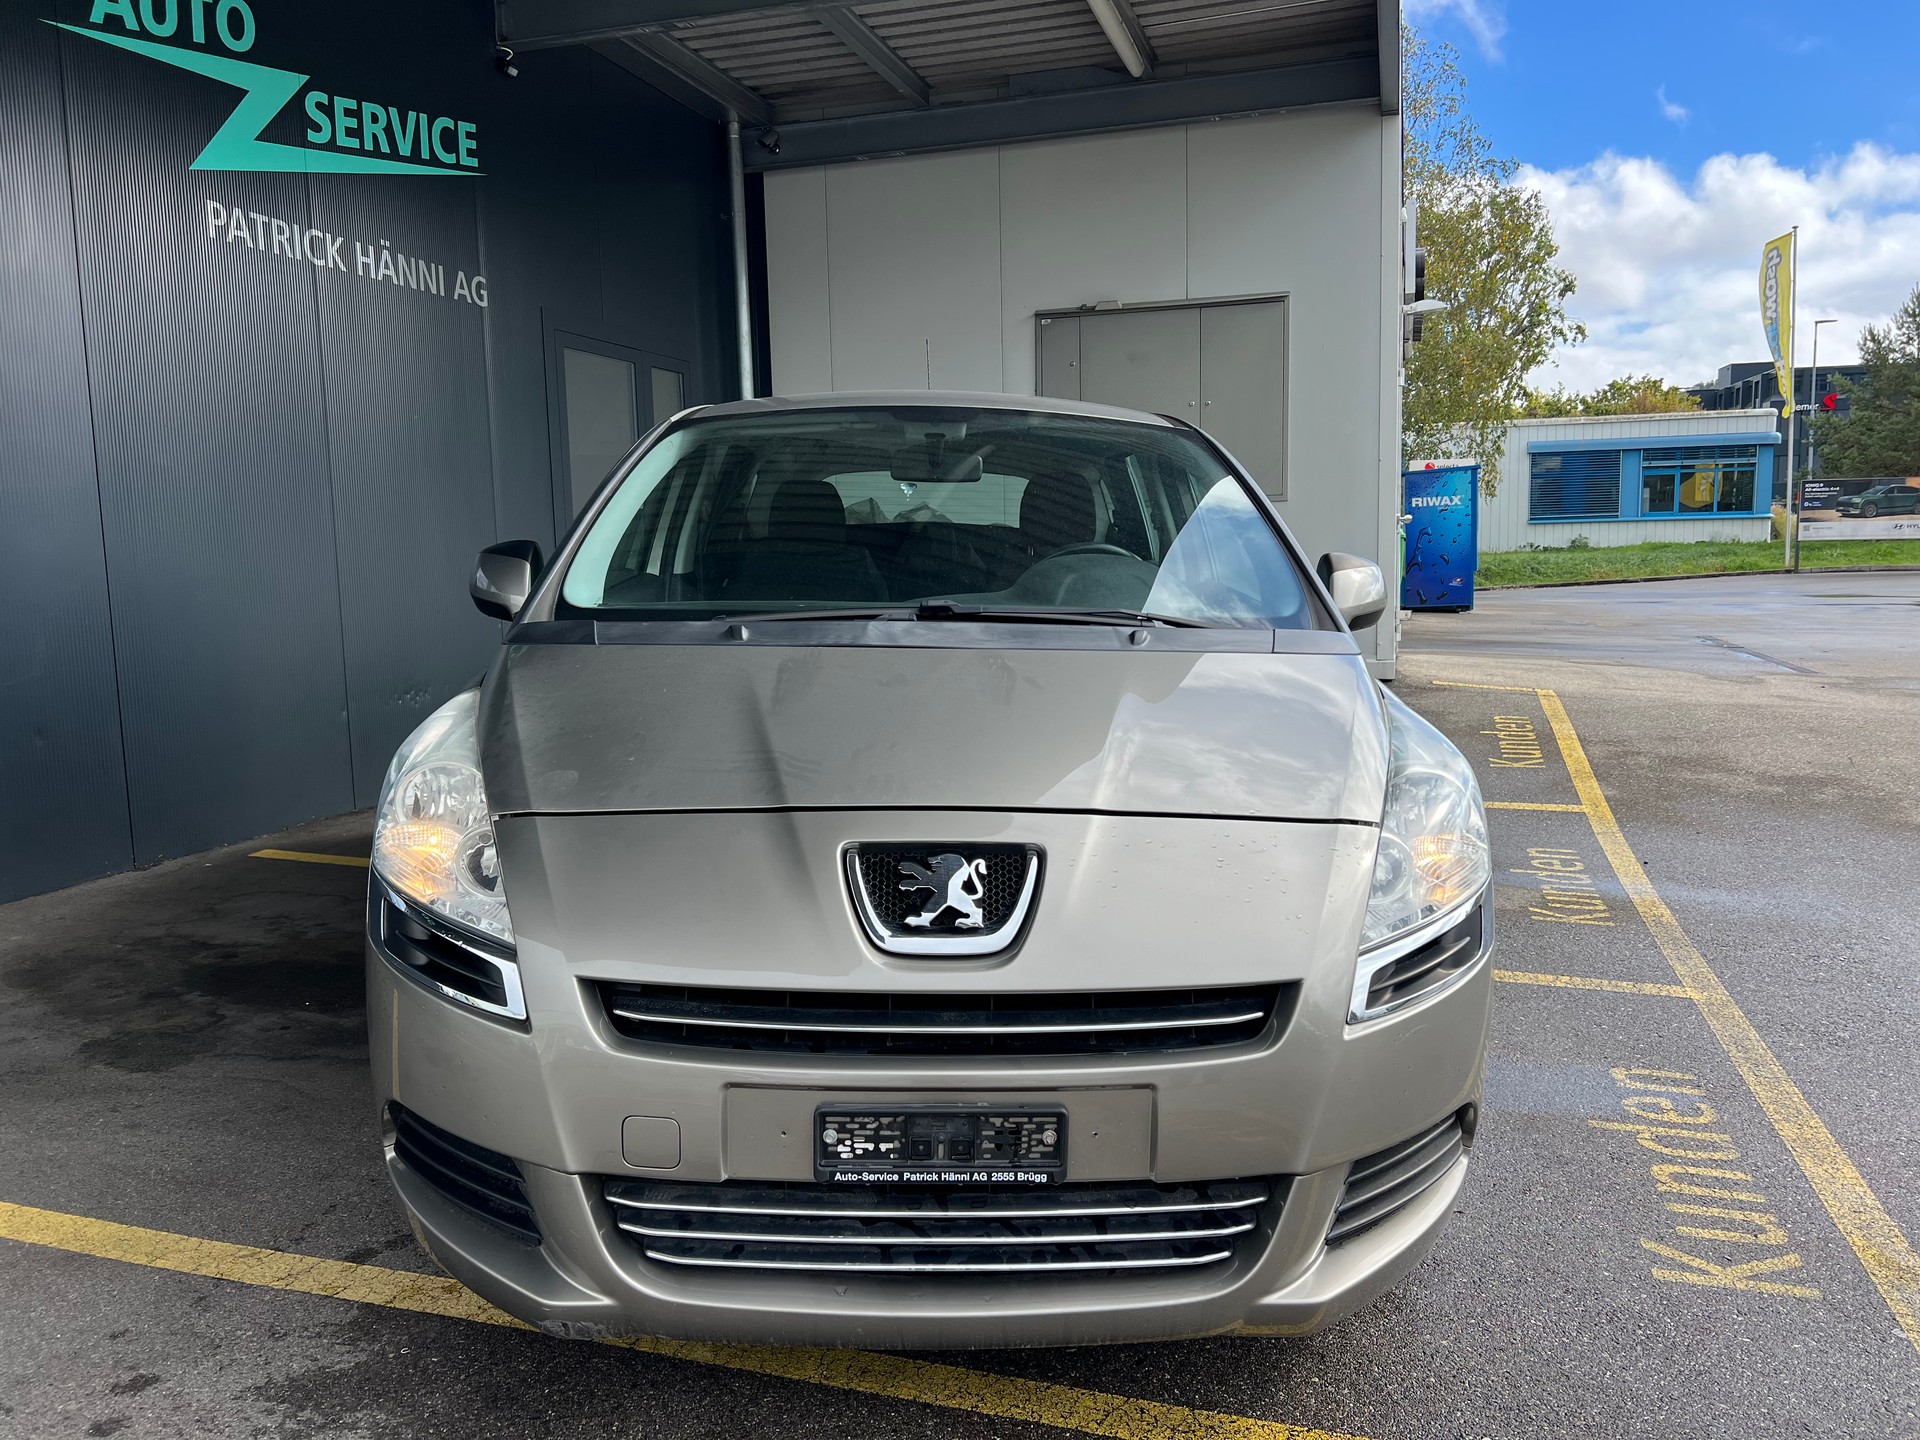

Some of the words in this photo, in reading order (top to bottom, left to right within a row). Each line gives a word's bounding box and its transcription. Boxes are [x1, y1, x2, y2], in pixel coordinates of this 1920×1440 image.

[304, 91, 479, 168] SERVICE
[206, 199, 347, 273] PATRICK
[355, 239, 445, 297] HÄNNI
[453, 270, 489, 308] AG
[1411, 495, 1462, 507] RIWAX
[1481, 715, 1546, 769] Kunden
[1510, 847, 1615, 926] Kunden
[834, 1171, 900, 1182] Auto-Service
[903, 1171, 939, 1182] Patrick
[941, 1171, 970, 1182] Hänni
[972, 1172, 988, 1182] AG
[991, 1172, 1015, 1182] 2555
[1017, 1171, 1048, 1184] Brügg
[1588, 1066, 1822, 1299] Kunden
